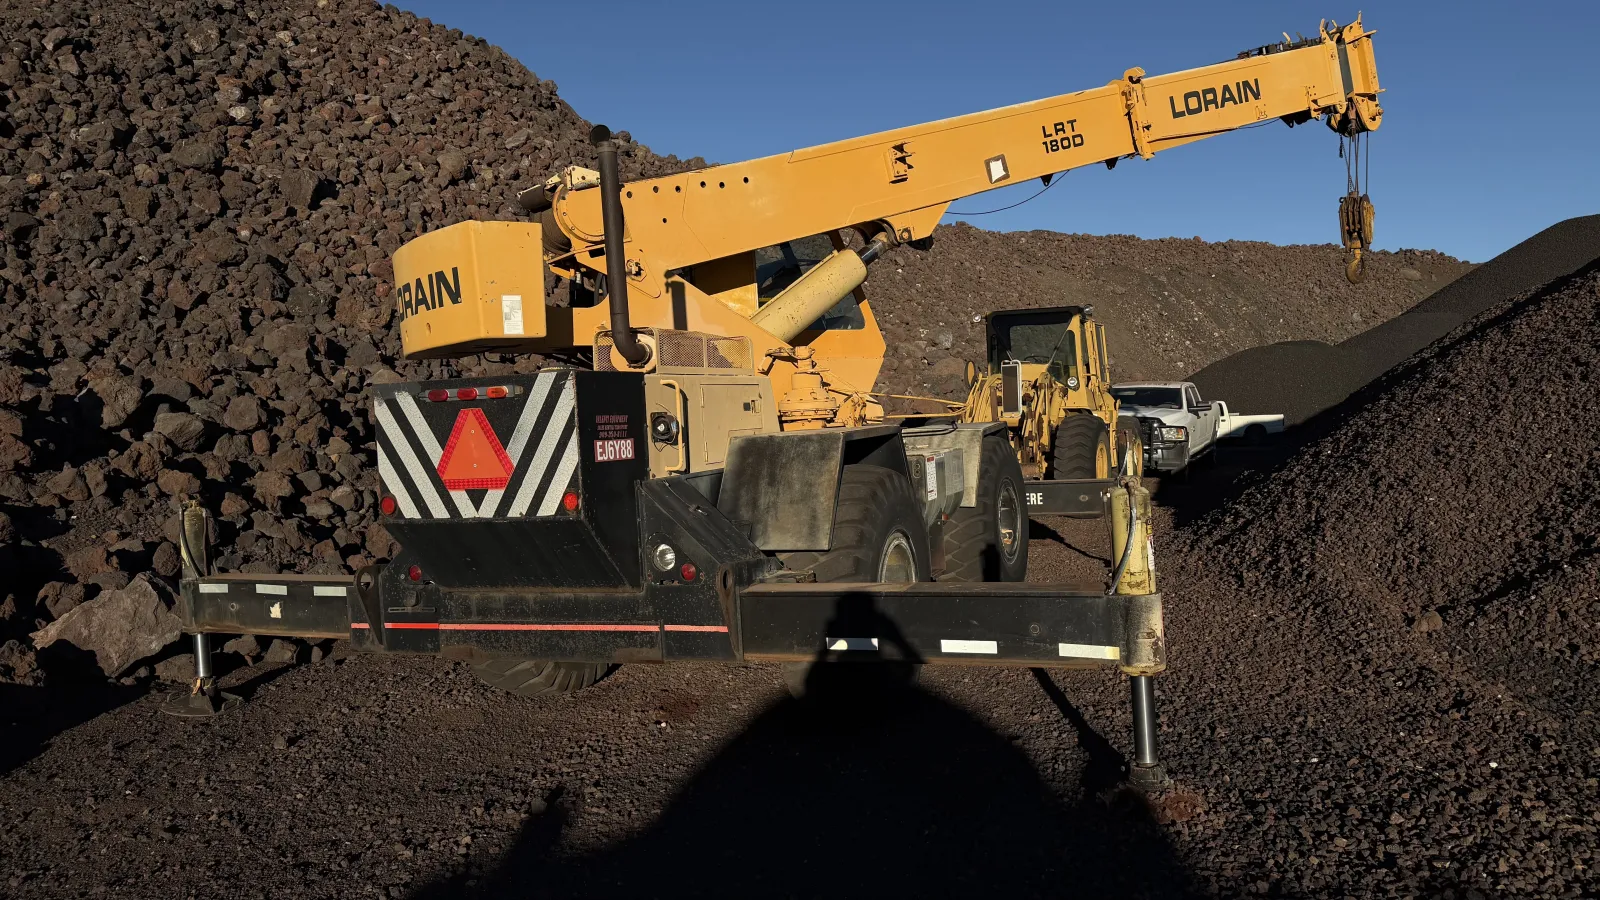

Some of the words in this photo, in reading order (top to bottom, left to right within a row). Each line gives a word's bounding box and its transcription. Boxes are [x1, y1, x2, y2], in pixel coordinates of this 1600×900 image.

[1169, 78, 1261, 119] LORAIN
[1042, 119, 1077, 138] LRT
[1042, 134, 1084, 153] 180D
[596, 439, 632, 461] EJ6Y88
